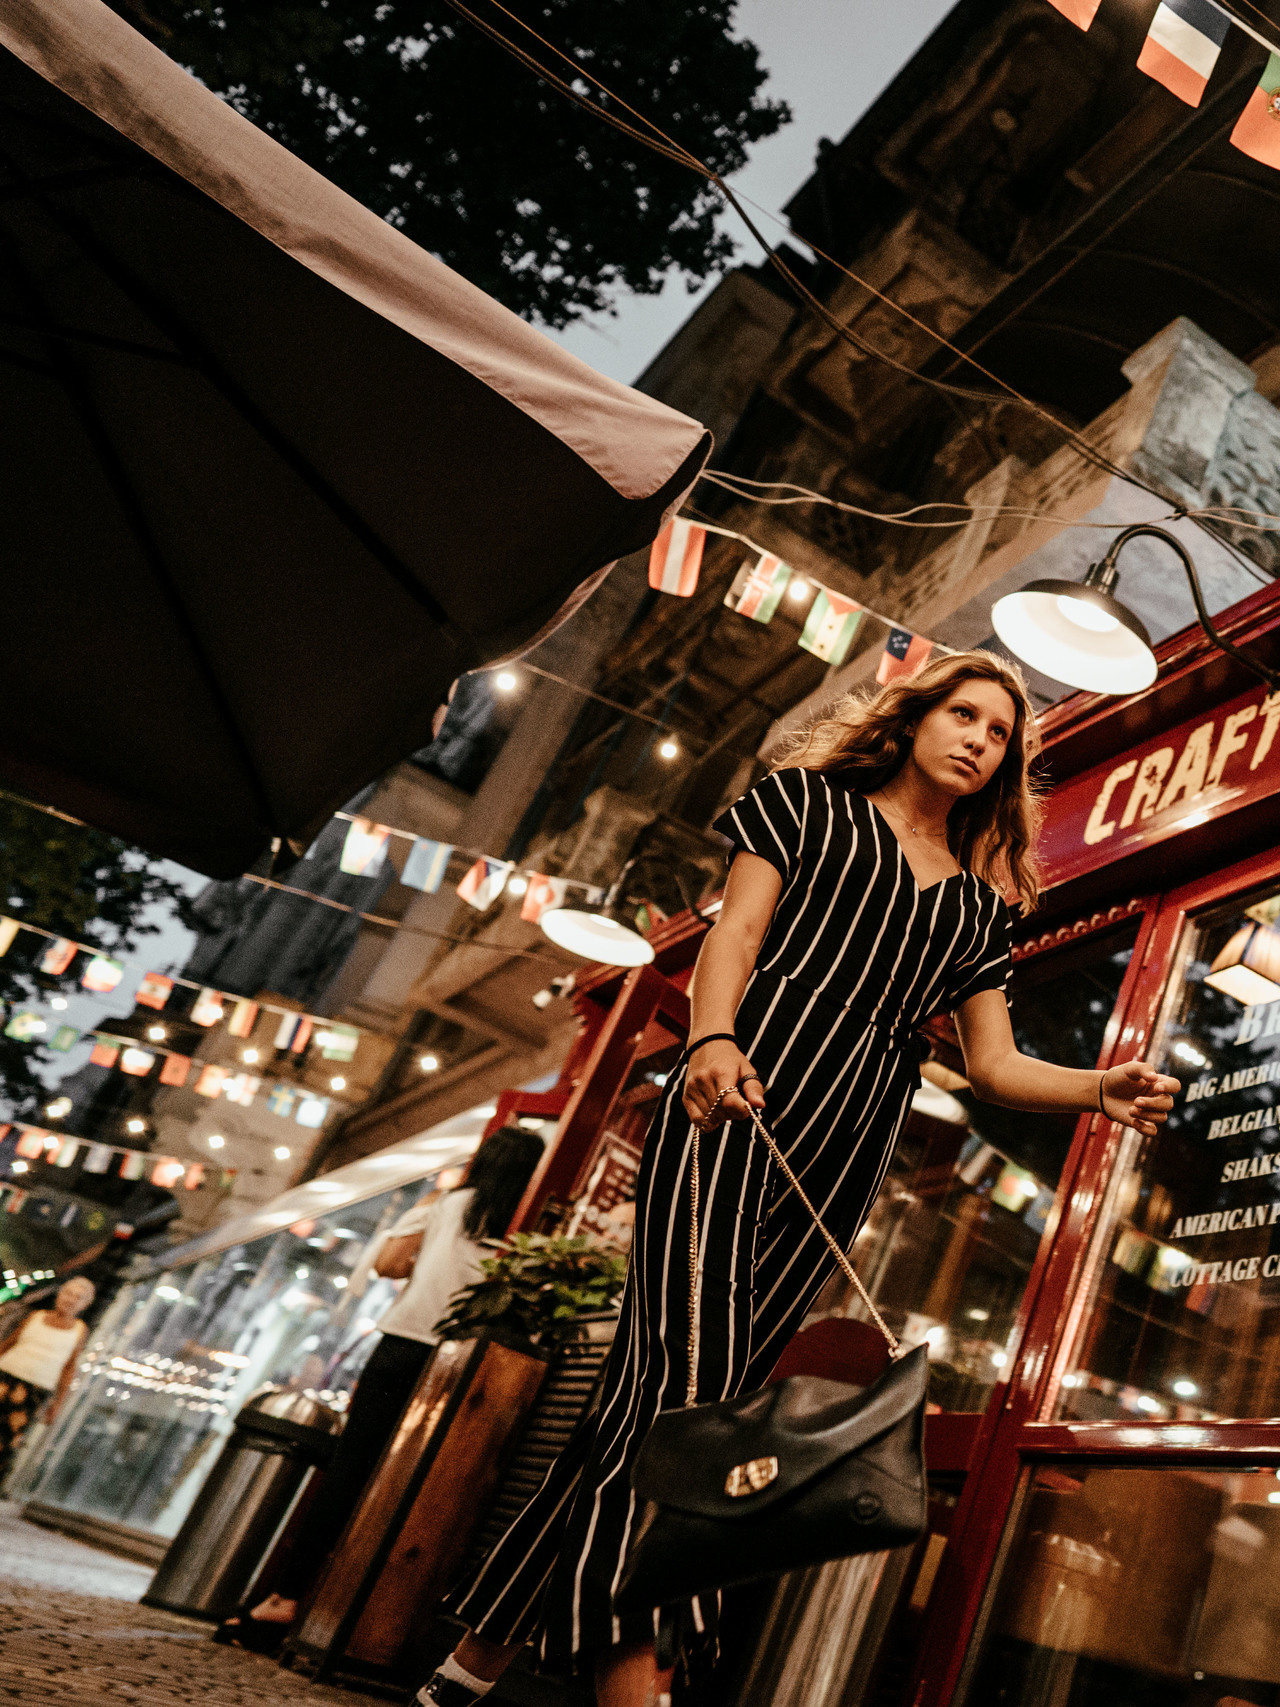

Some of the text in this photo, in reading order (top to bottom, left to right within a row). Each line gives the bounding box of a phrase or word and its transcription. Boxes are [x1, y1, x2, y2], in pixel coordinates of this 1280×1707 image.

[1185, 1077, 1218, 1103] BIG
[1169, 1204, 1270, 1239] AMERICAN
[1170, 1256, 1262, 1288] COTTAGE
